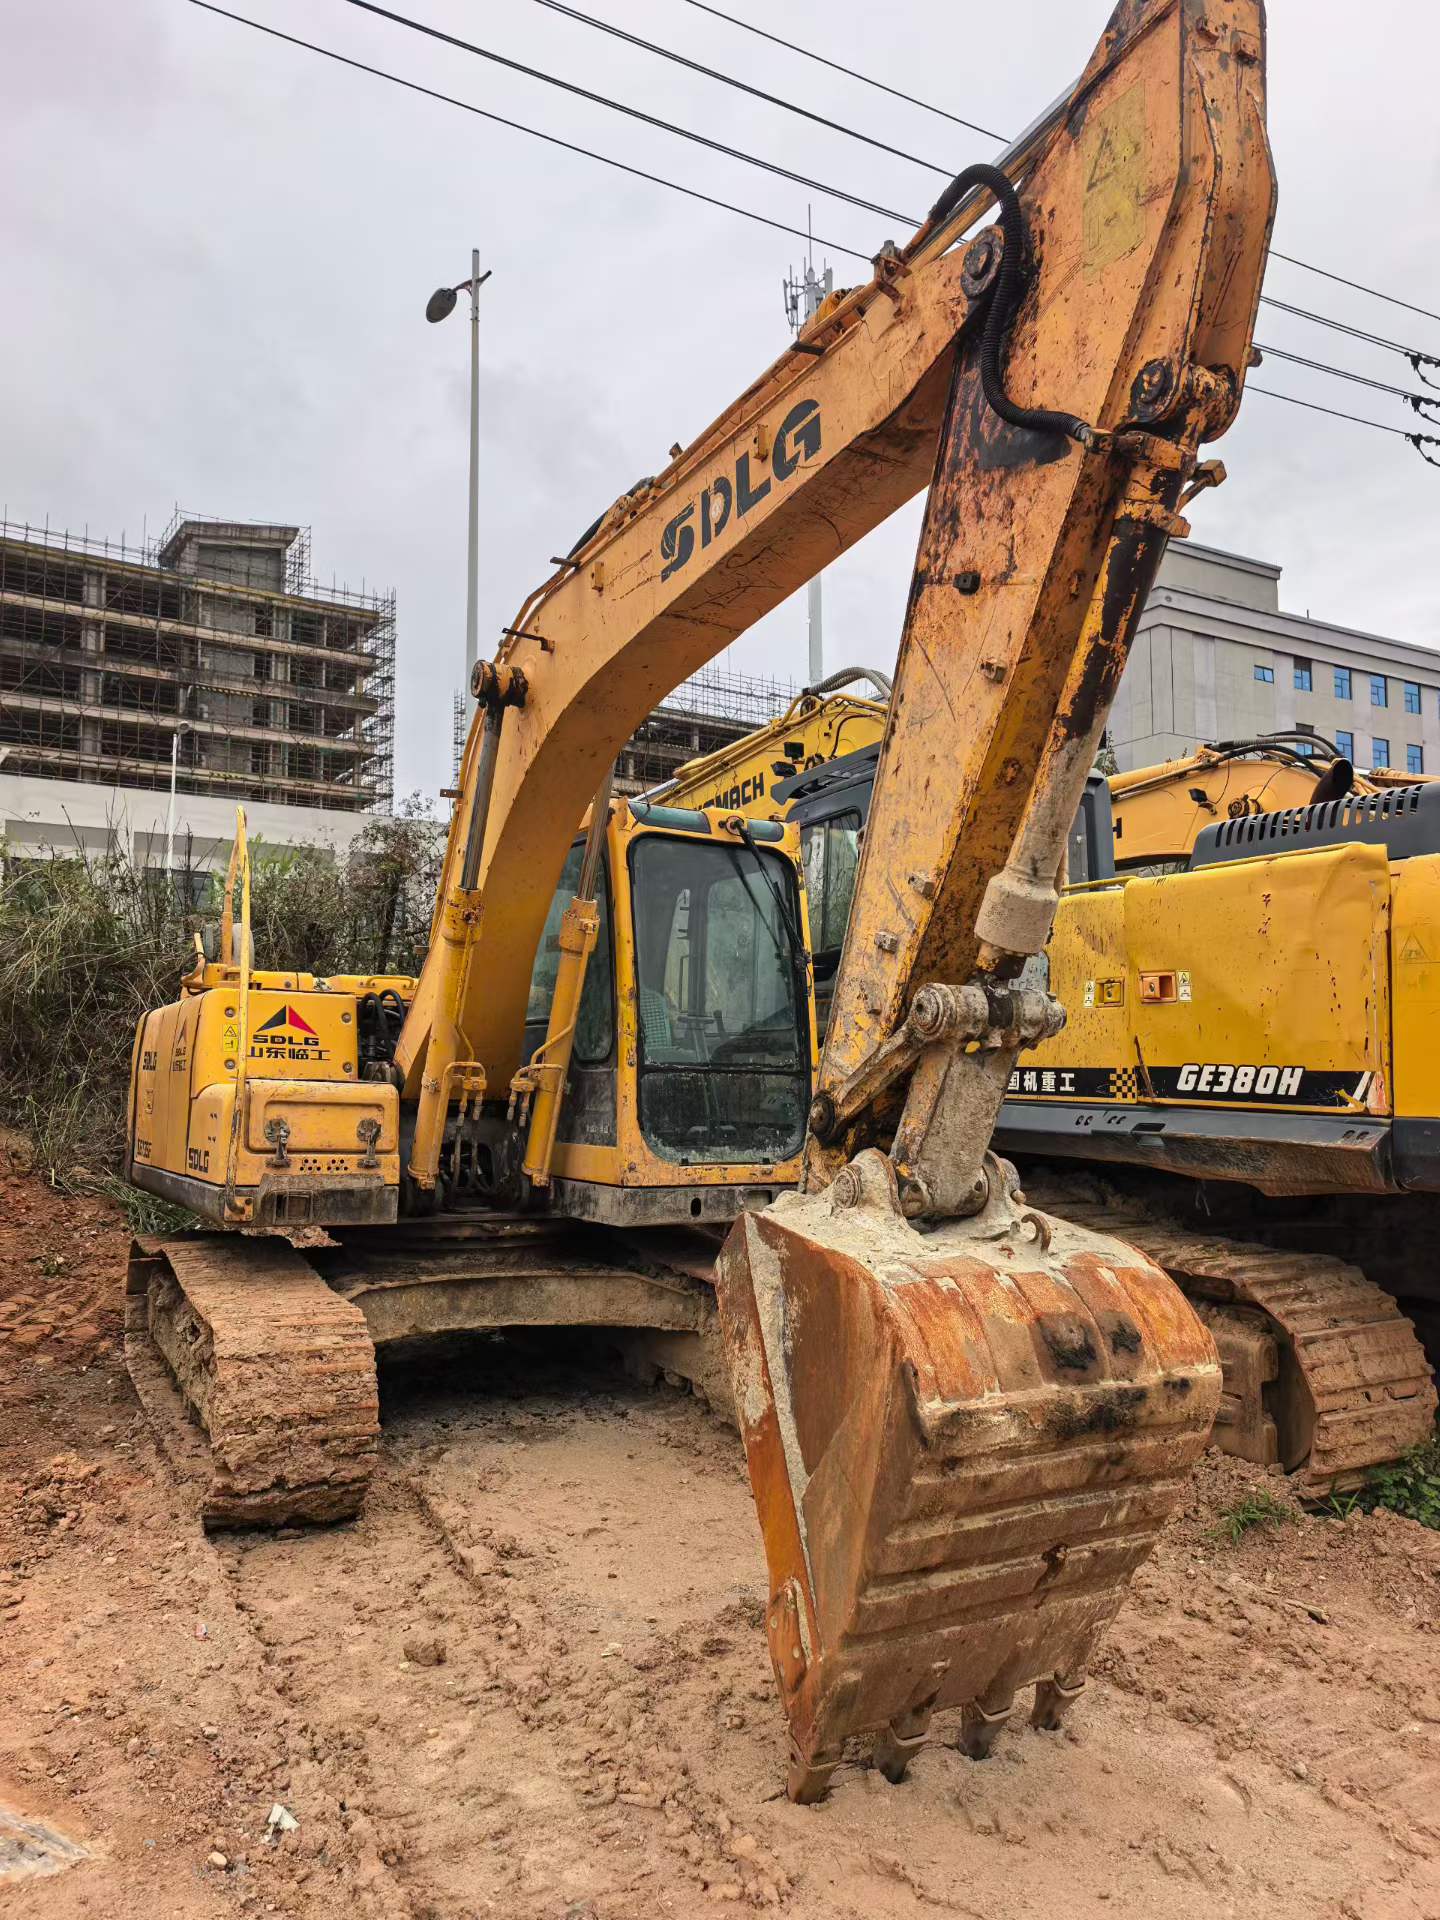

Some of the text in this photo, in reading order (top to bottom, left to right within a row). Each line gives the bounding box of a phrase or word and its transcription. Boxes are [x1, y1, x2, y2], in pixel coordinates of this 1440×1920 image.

[660, 398, 822, 584] SDLG
[252, 1034, 320, 1046] SDLG
[1176, 1064, 1304, 1096] GE380H
[187, 1148, 210, 1173] SDLG
